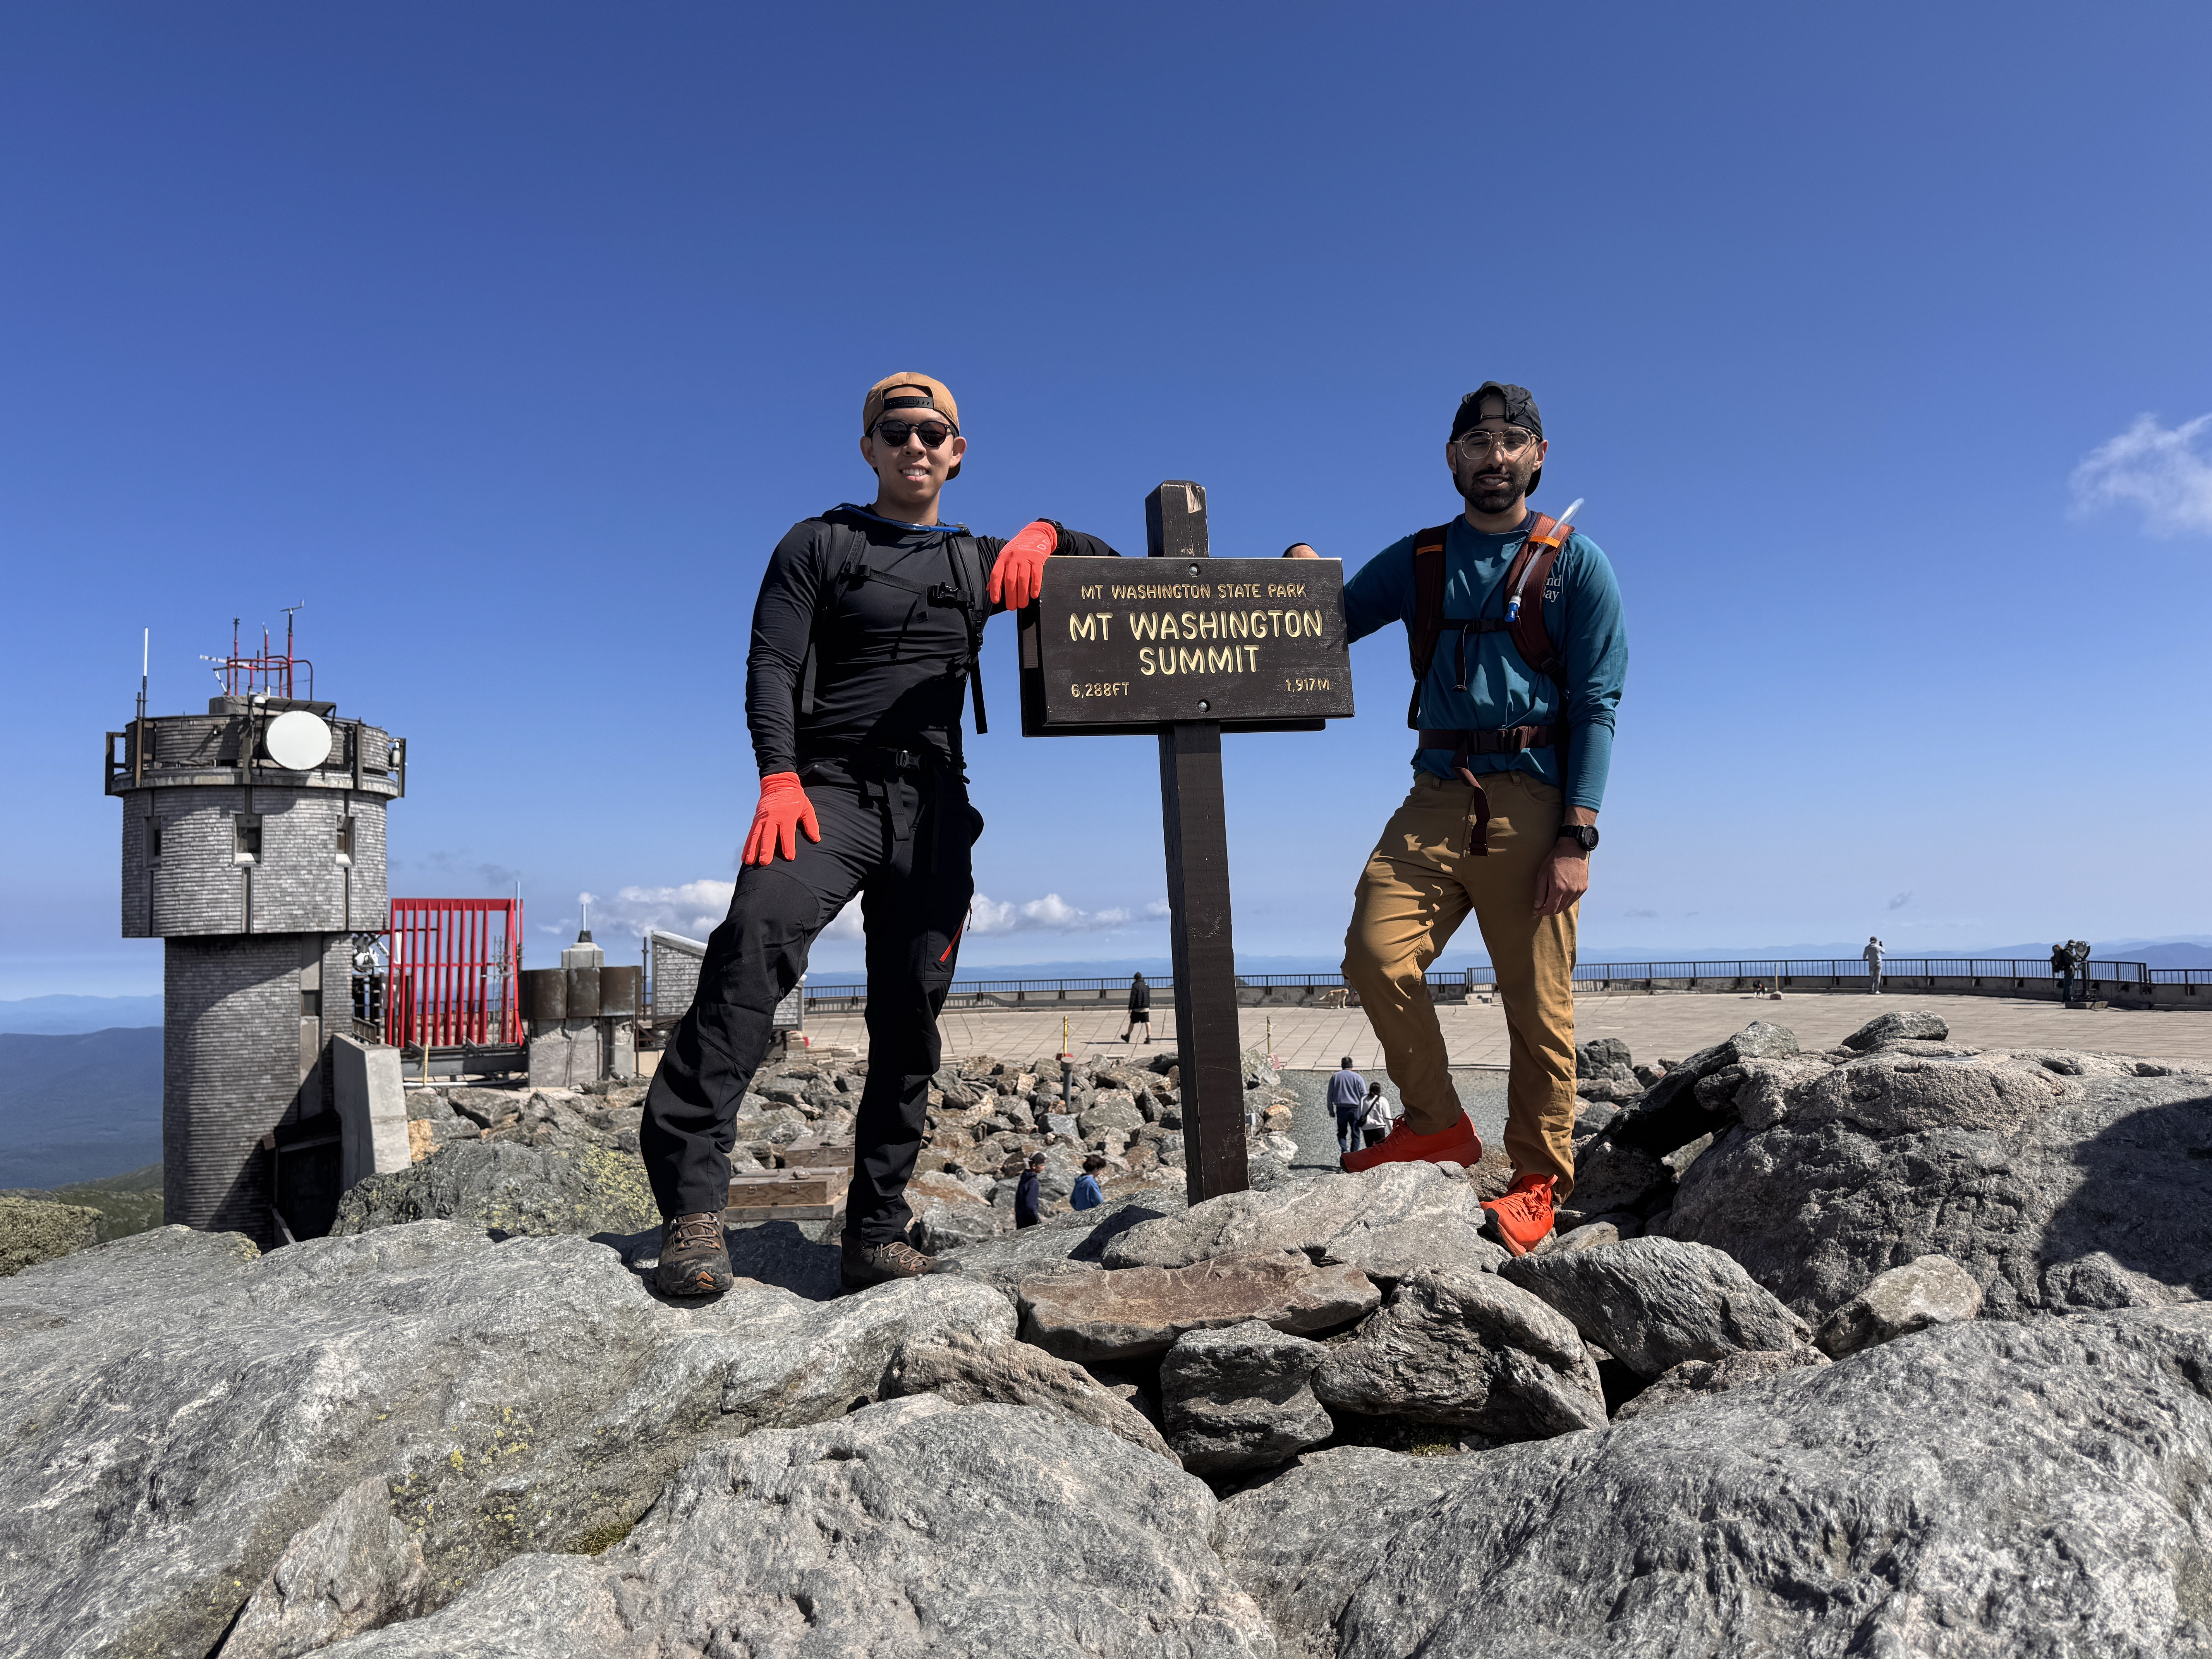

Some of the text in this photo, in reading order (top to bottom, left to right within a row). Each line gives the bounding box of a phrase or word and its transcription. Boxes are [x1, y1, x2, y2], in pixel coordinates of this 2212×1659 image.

[1081, 583, 1307, 599] MT WASHINGTON STATE PARK
[1070, 609, 1323, 641] MT WASHINGTON
[1139, 645, 1260, 676] SUMMIT
[1071, 682, 1130, 699] 6,288FT
[1286, 677, 1330, 693] 1,917M
